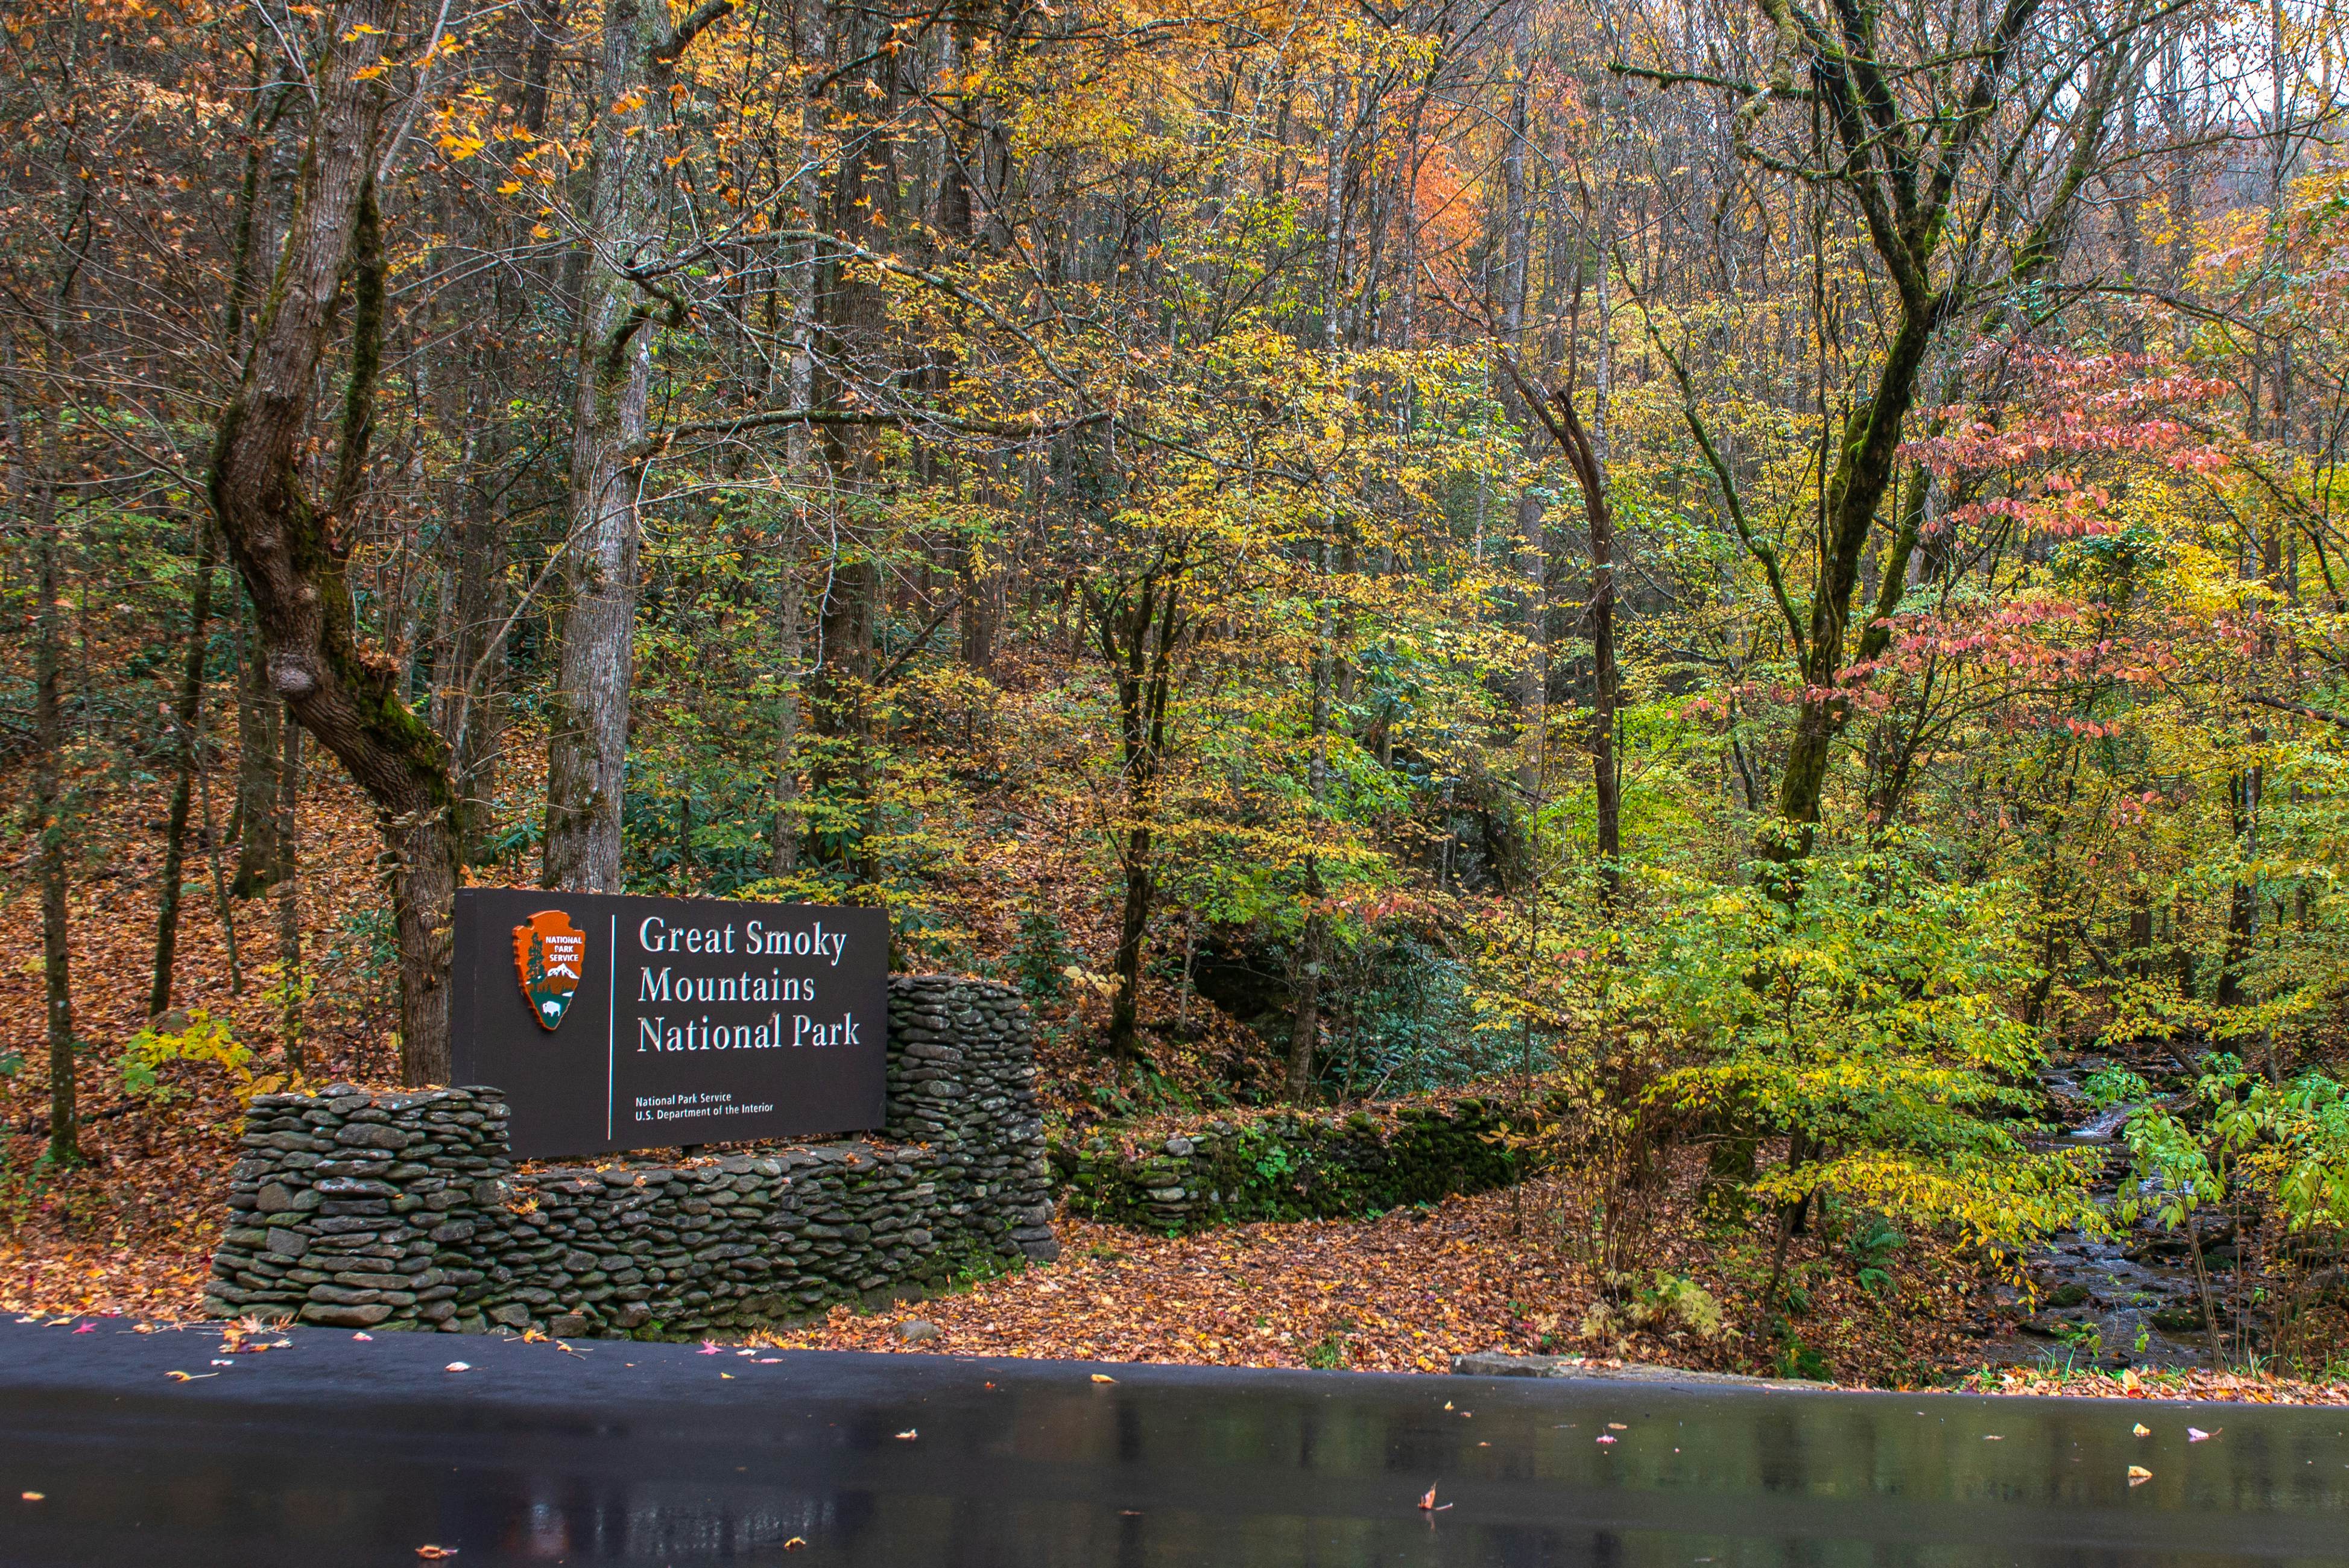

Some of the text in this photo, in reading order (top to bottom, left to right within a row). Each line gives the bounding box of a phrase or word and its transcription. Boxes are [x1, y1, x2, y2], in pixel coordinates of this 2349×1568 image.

[545, 936, 583, 944] NATIONAL
[639, 916, 847, 966] Great Smoky
[549, 953, 579, 962] SERVICE
[637, 966, 814, 1002] Mountains
[637, 1011, 860, 1052] National Park
[636, 1092, 732, 1107] National Park Service
[635, 1102, 773, 1122] U.S. Department of the Interior
